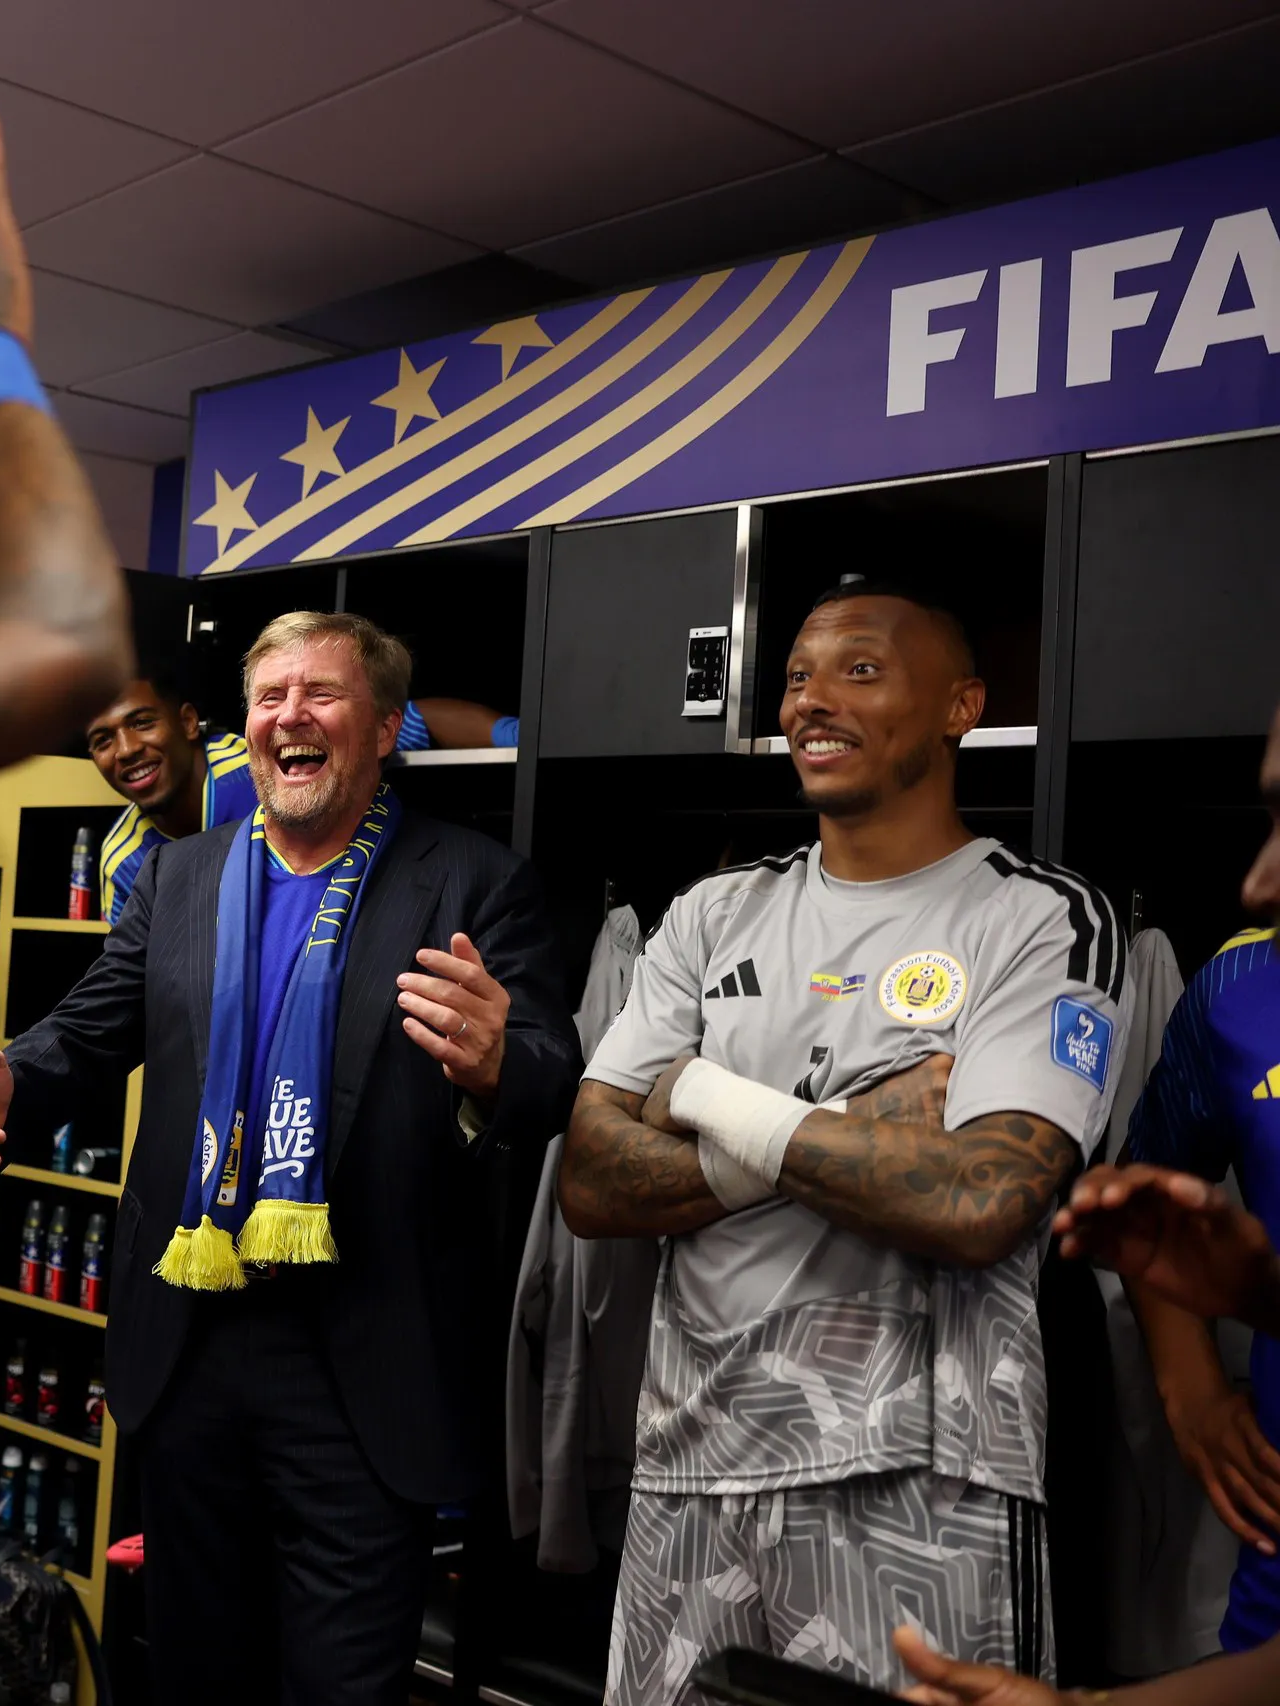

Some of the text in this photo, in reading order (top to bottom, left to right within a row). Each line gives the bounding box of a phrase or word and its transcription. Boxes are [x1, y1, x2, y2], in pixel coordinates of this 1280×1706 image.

[886, 207, 1280, 417] FIFA
[884, 956, 921, 1007] Federashon
[1068, 1043, 1098, 1071] PEACE
[1076, 1060, 1091, 1075] FIFA
[267, 1097, 312, 1129] UE
[262, 1127, 316, 1161] AVE
